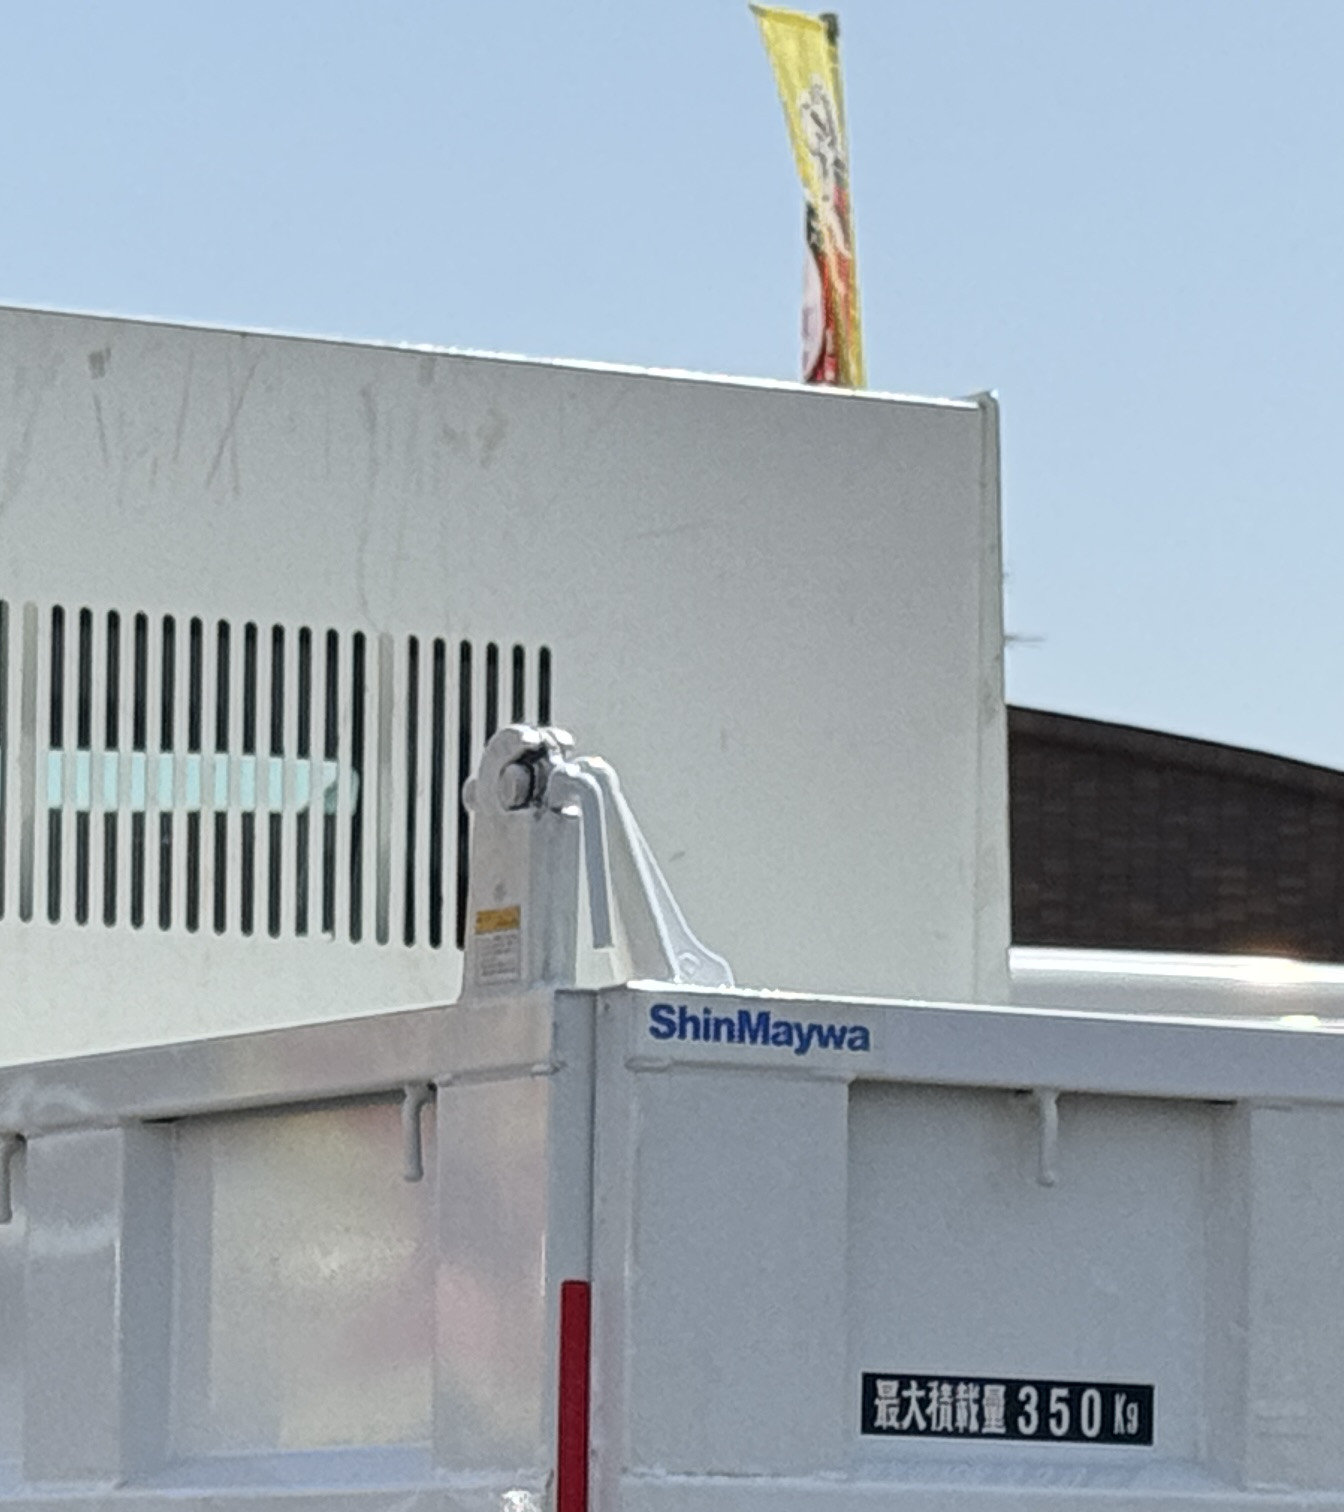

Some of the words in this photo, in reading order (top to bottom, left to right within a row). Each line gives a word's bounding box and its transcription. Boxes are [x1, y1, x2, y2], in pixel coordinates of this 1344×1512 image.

[649, 1003, 871, 1056] ShinMaywa
[873, 1379, 1006, 1435] 最大積載量
[1017, 1385, 1102, 1438] 350
